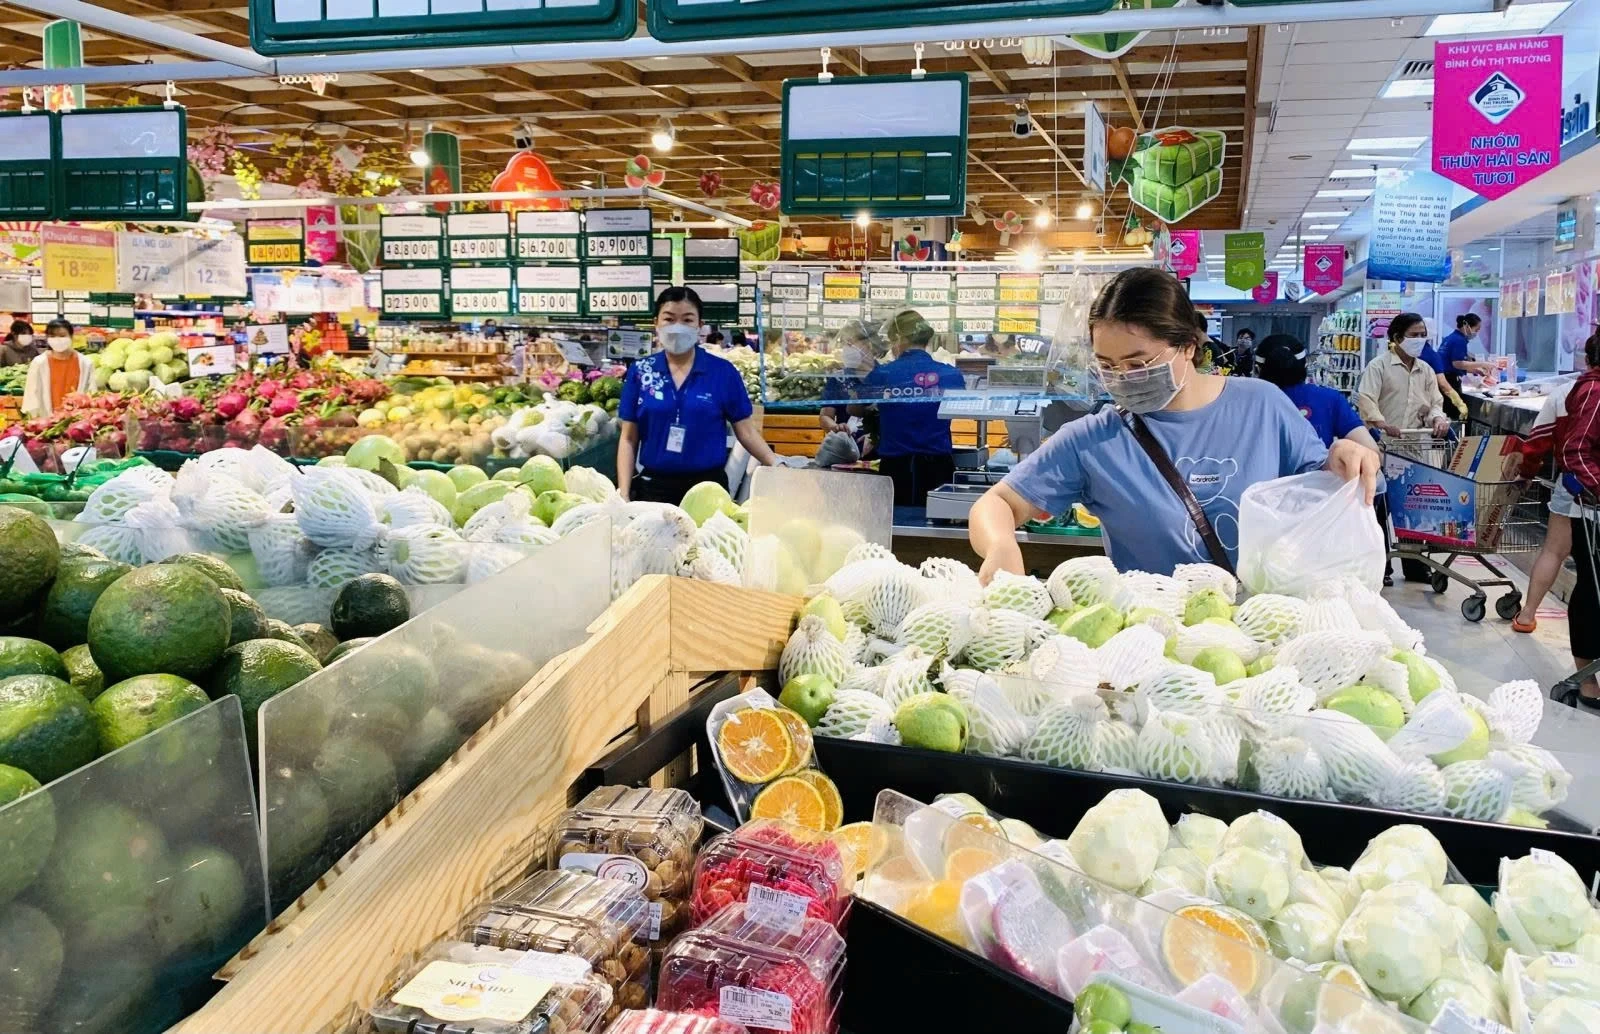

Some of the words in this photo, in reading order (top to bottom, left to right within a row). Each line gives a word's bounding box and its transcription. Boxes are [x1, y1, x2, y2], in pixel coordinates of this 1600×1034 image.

[1448, 45, 1469, 55] KHU
[1471, 44, 1493, 54] VỰC
[1519, 39, 1549, 49] HÀNG
[1488, 57, 1504, 67] THỊ
[1471, 133, 1520, 149] NHÓM
[1440, 152, 1482, 169] THỦY
[1485, 149, 1513, 167] HẢI
[1517, 148, 1551, 165] SẢN
[1474, 172, 1514, 185] TƯƠI
